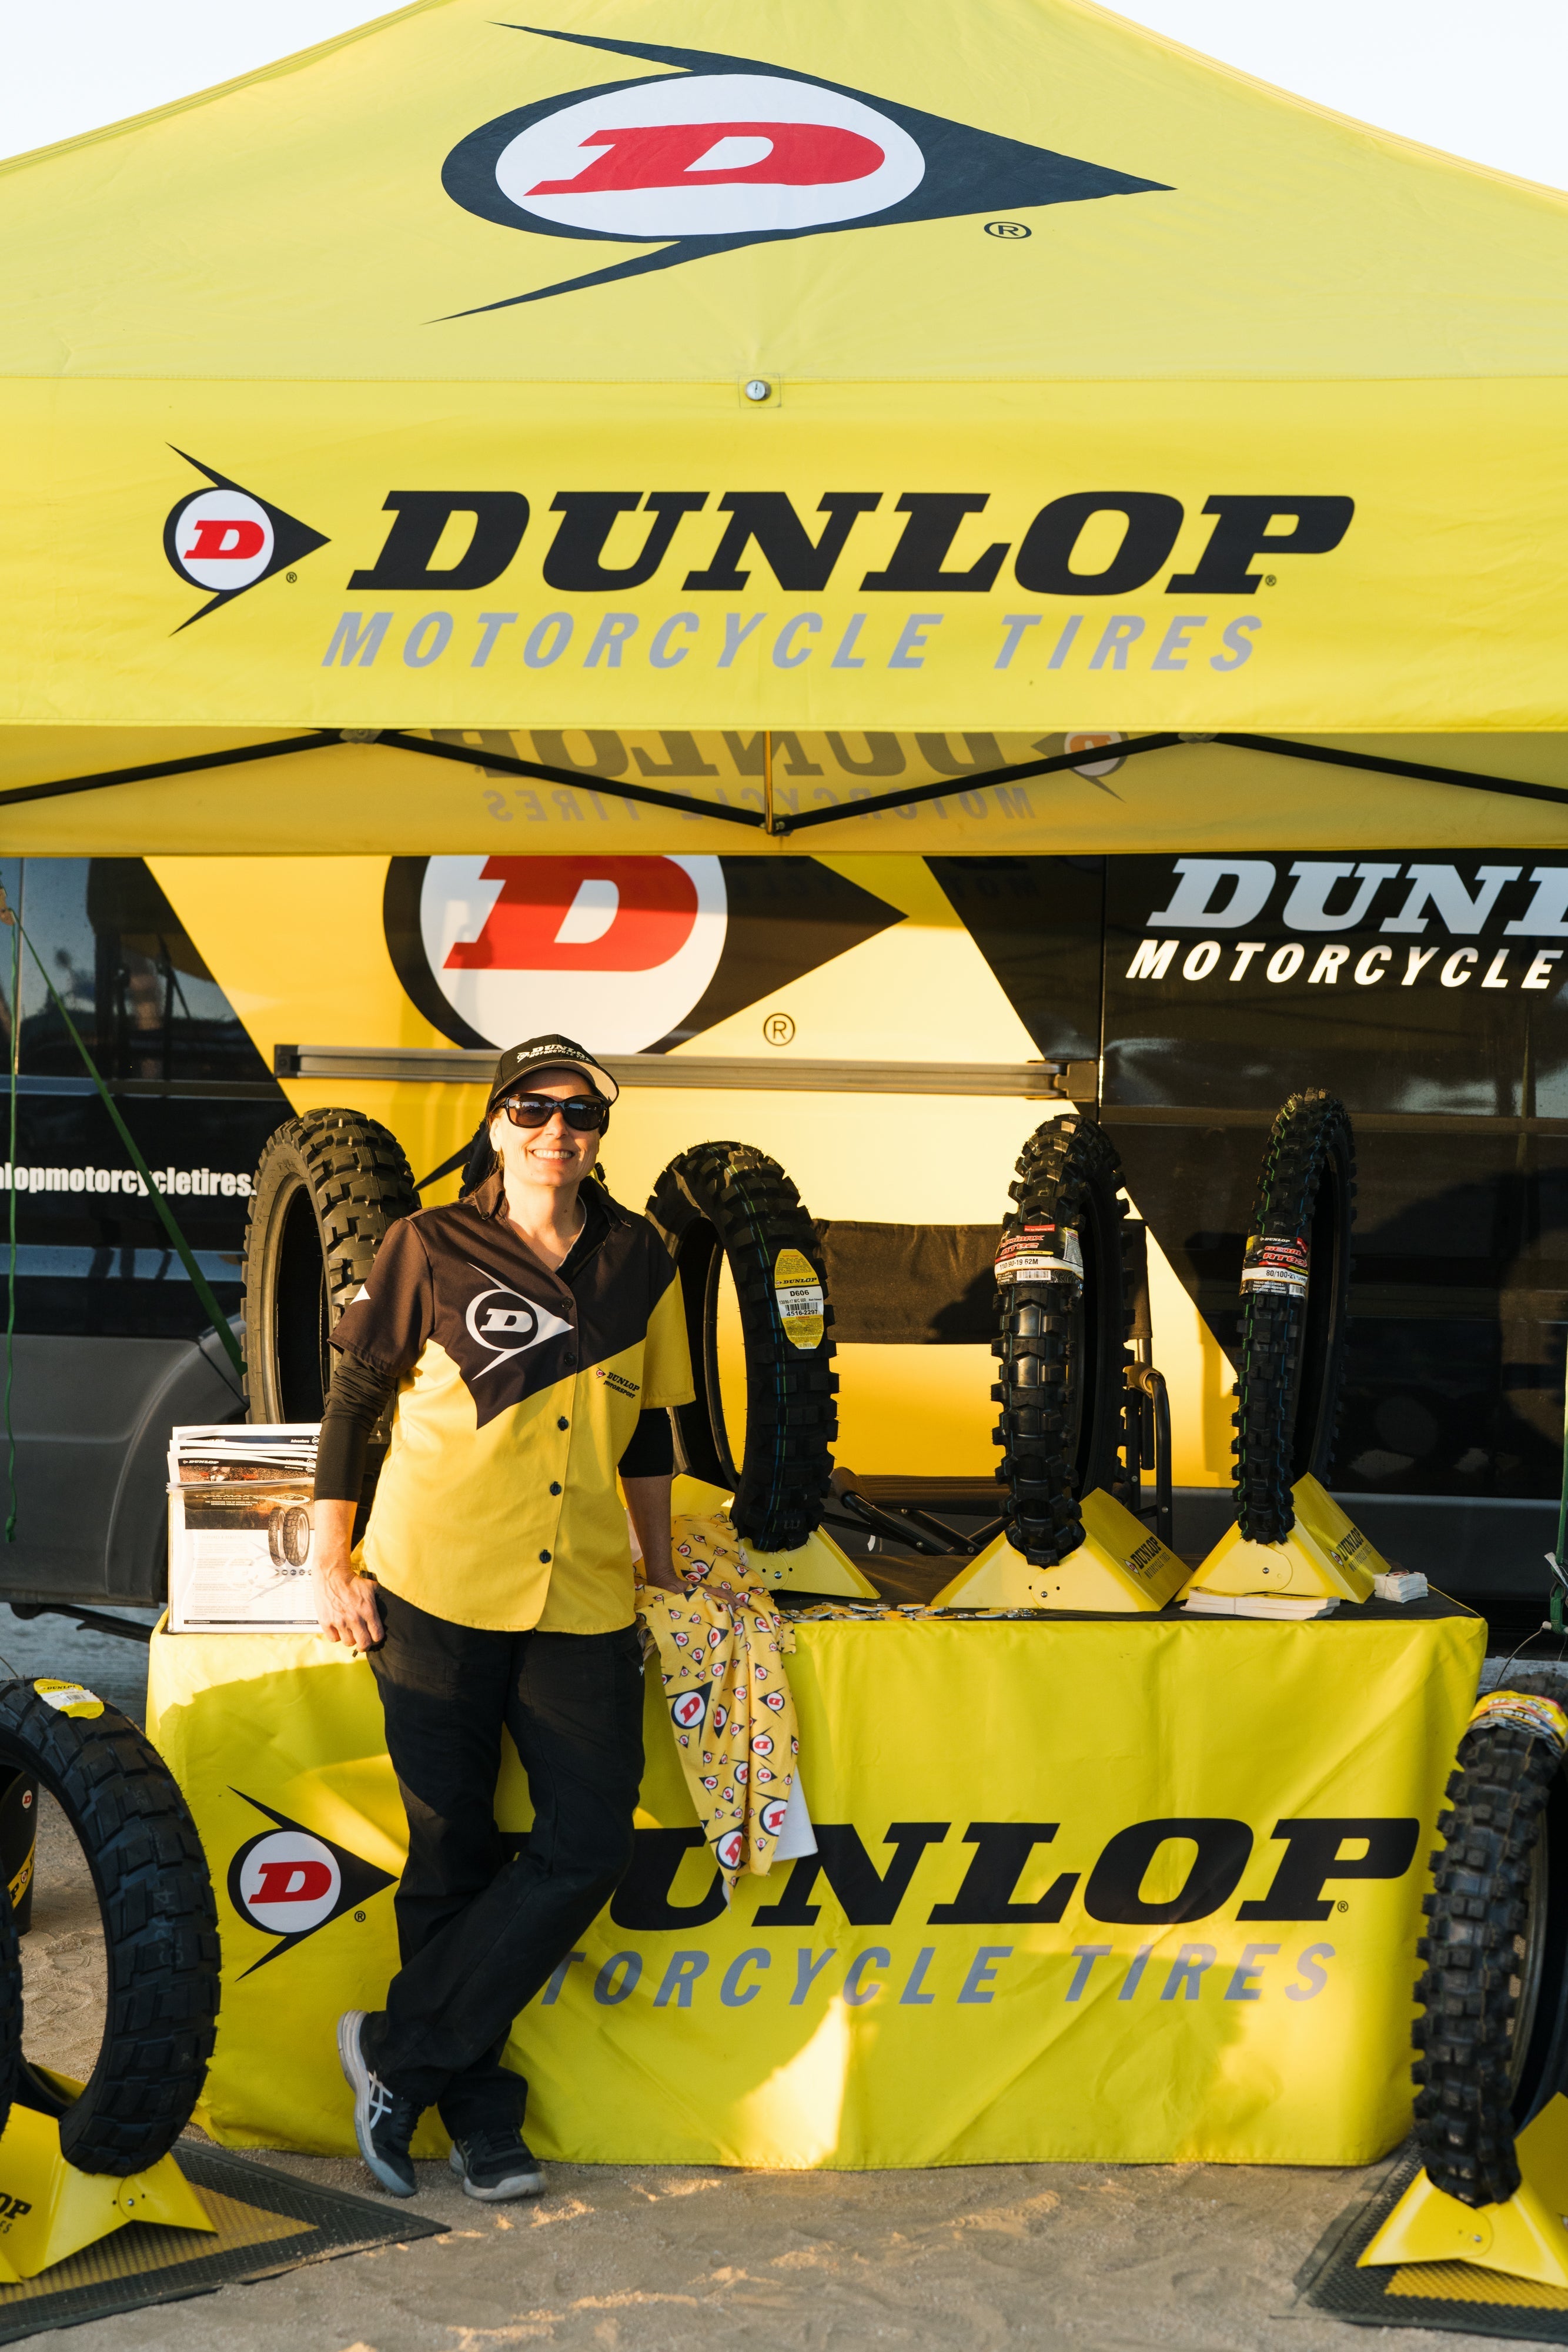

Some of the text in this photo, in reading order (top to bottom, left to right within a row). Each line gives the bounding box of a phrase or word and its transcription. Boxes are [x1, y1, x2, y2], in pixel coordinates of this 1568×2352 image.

[522, 121, 886, 197] D
[183, 520, 266, 560] D
[346, 490, 1355, 596] DUNLOP
[321, 611, 1263, 672] MOTORCYCLE TIRES
[442, 856, 699, 972] D
[1125, 939, 1565, 990] MOTORCYCLE
[999, 1259, 1023, 1270] 110/90-19
[479, 1308, 533, 1332] D
[607, 1372, 640, 1391] DUNLOP
[1129, 1536, 1162, 1569] DUNLOP
[1336, 1527, 1364, 1561] DUNLOP
[248, 1860, 332, 1904] D
[497, 1818, 1419, 1930] UNLOP
[540, 1943, 1336, 2008] TORCYCLE TIRES
